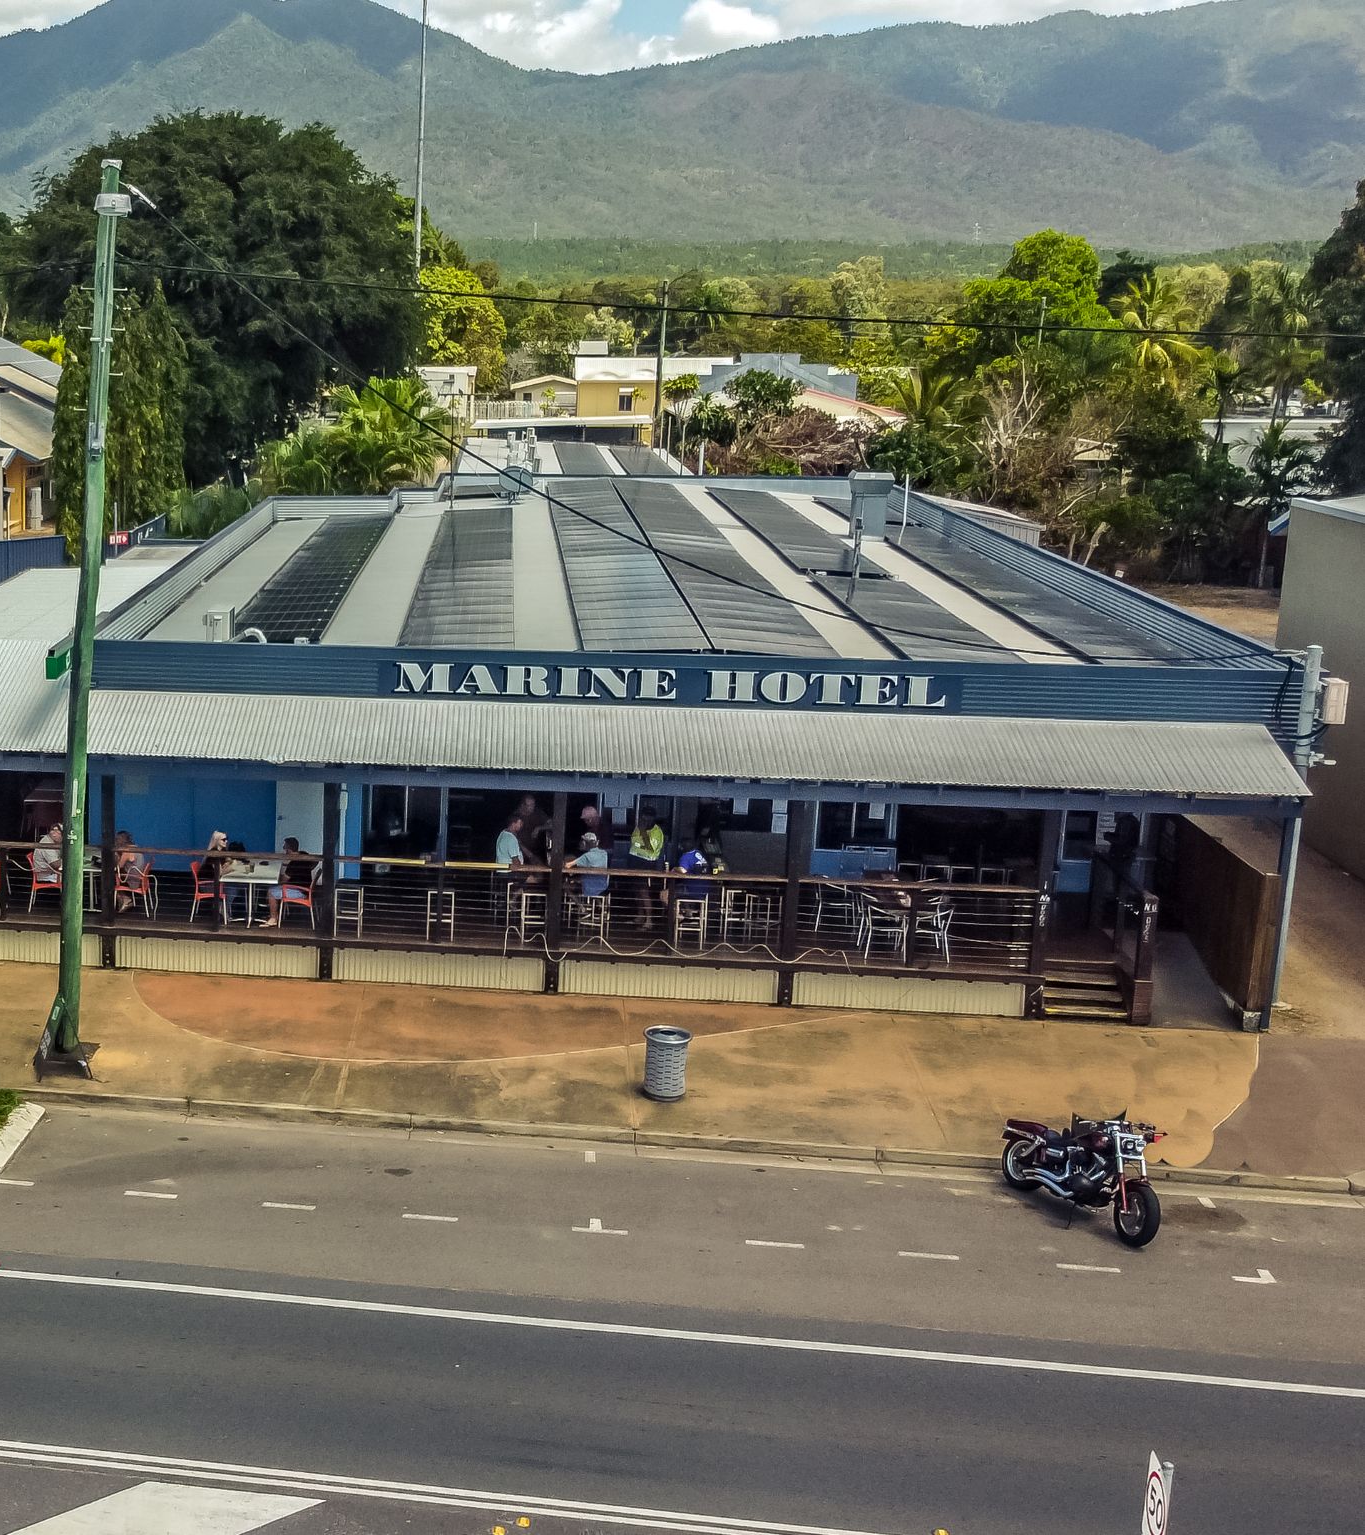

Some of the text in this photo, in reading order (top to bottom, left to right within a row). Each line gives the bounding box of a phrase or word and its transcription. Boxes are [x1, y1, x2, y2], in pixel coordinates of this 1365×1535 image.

[394, 662, 946, 707] MARINE HOTEL
[1148, 1484, 1163, 1529] 50
